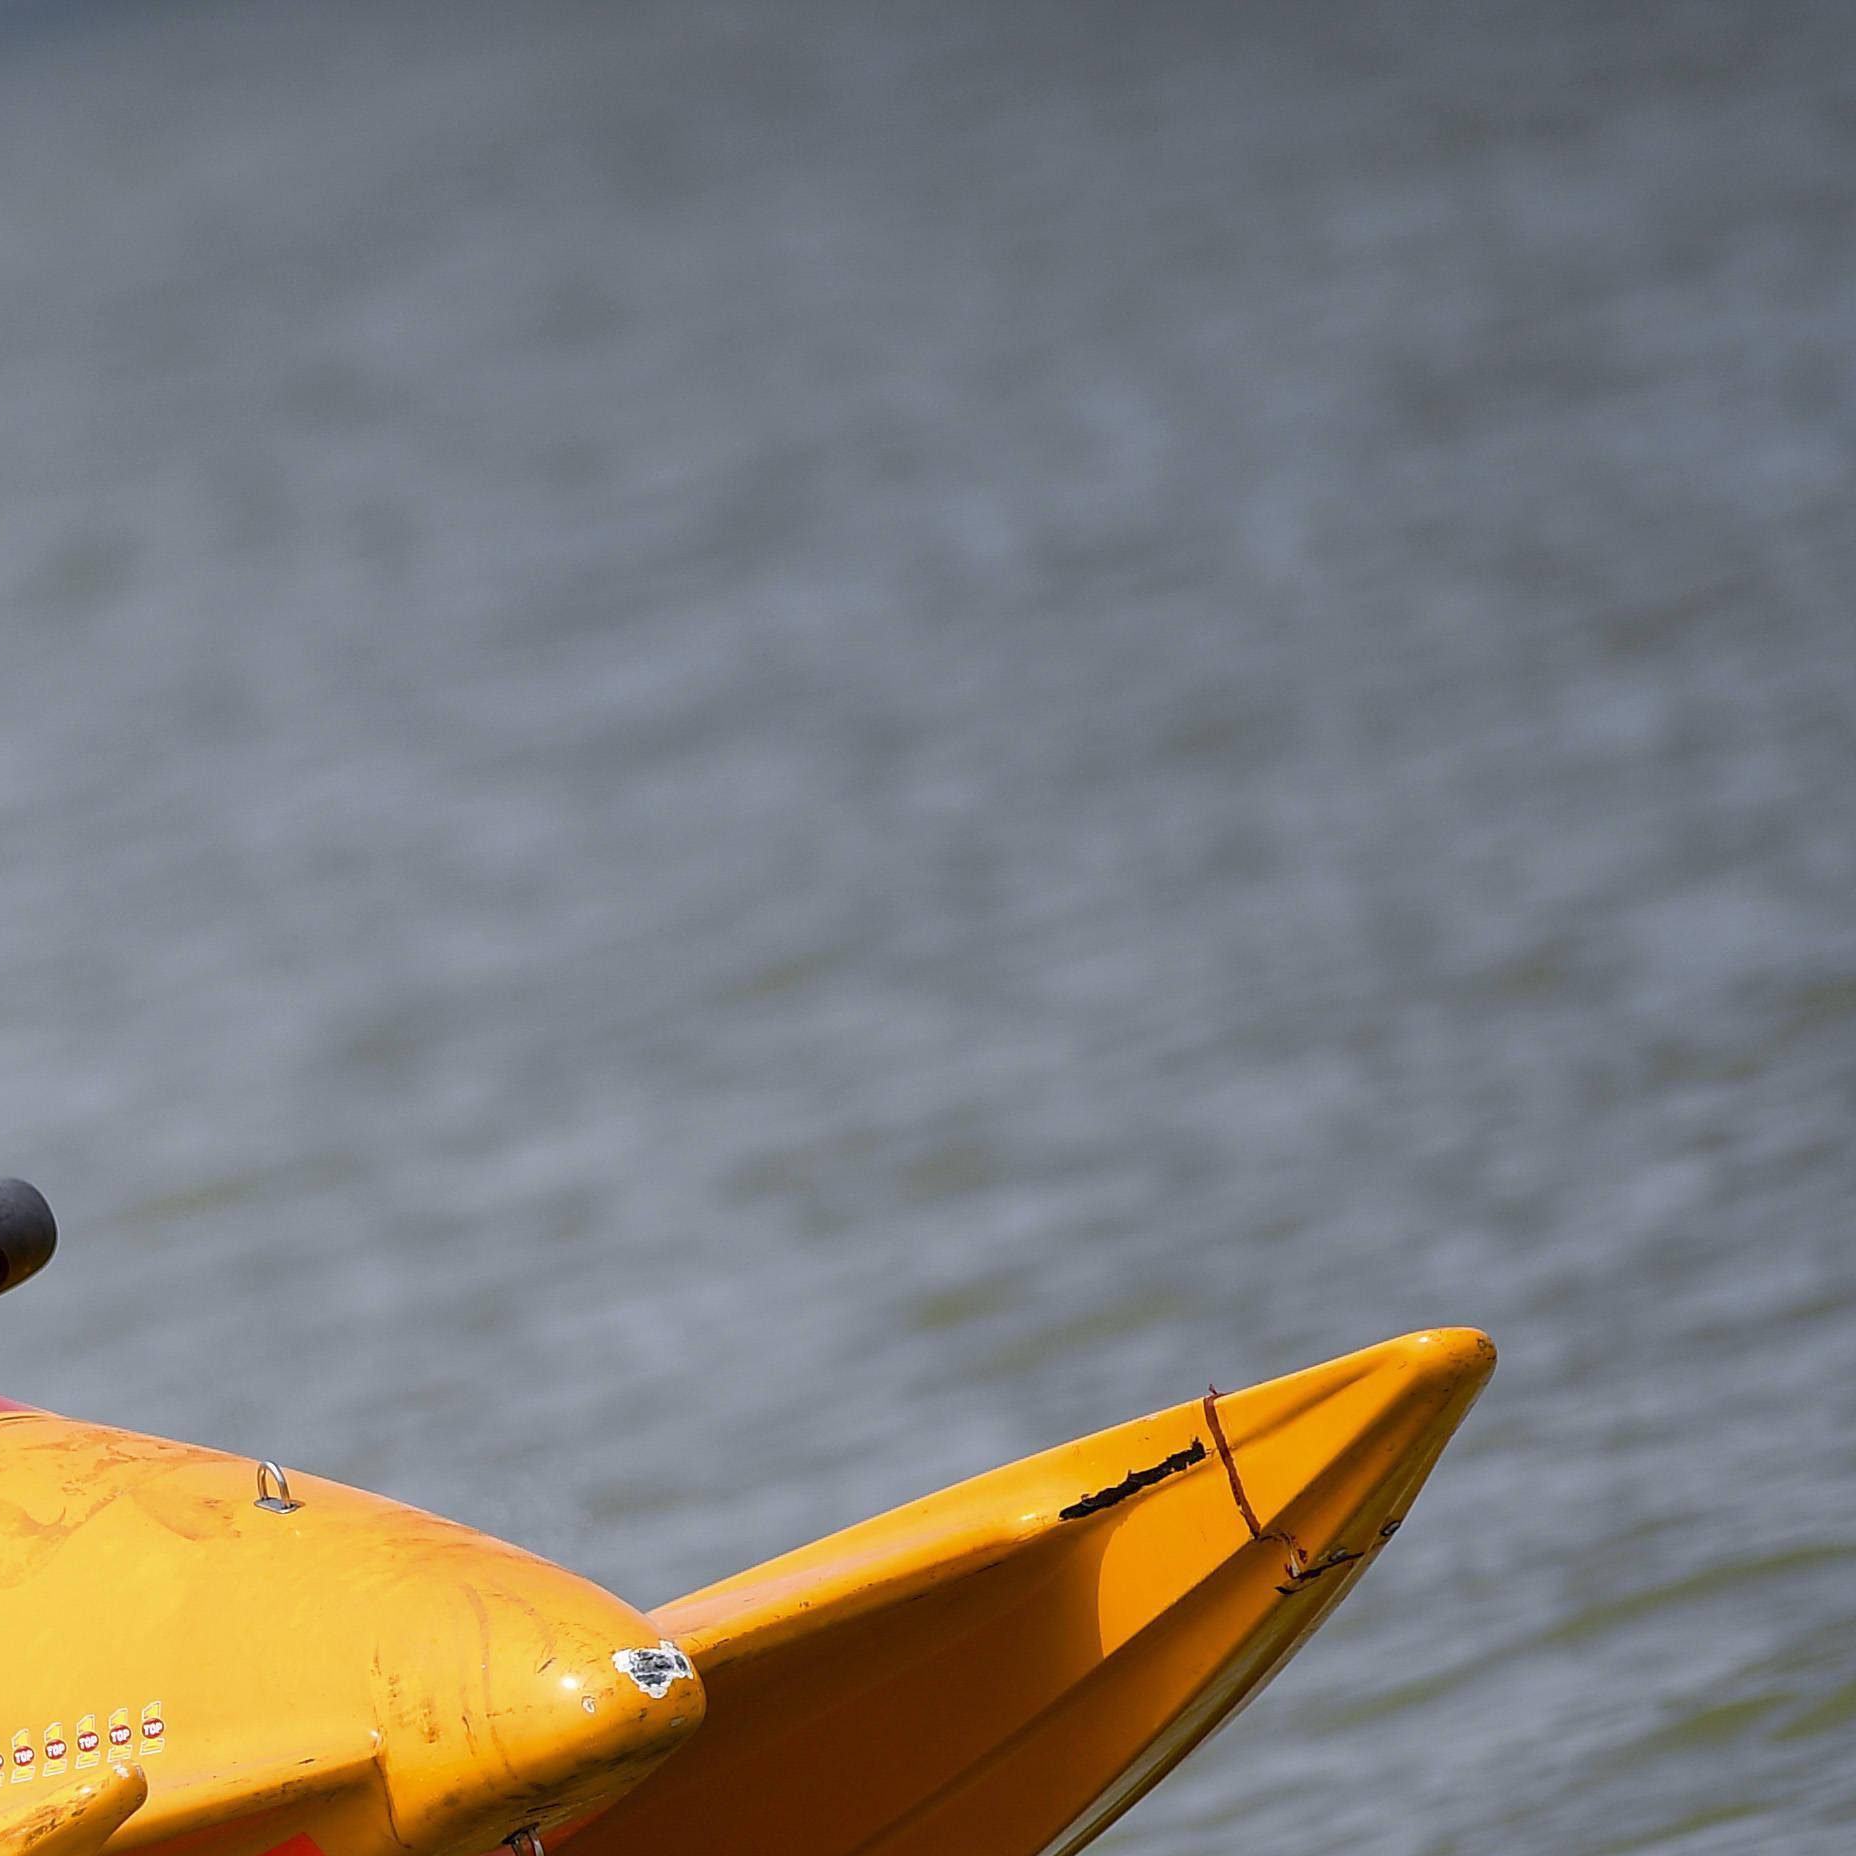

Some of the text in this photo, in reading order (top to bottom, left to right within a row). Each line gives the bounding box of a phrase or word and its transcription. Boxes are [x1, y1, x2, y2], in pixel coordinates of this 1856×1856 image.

[111, 1728, 130, 1742] TOP
[143, 1721, 163, 1736] TOP
[47, 1742, 66, 1756] TOP
[78, 1735, 98, 1749] TOP
[15, 1749, 33, 1763] TOP
